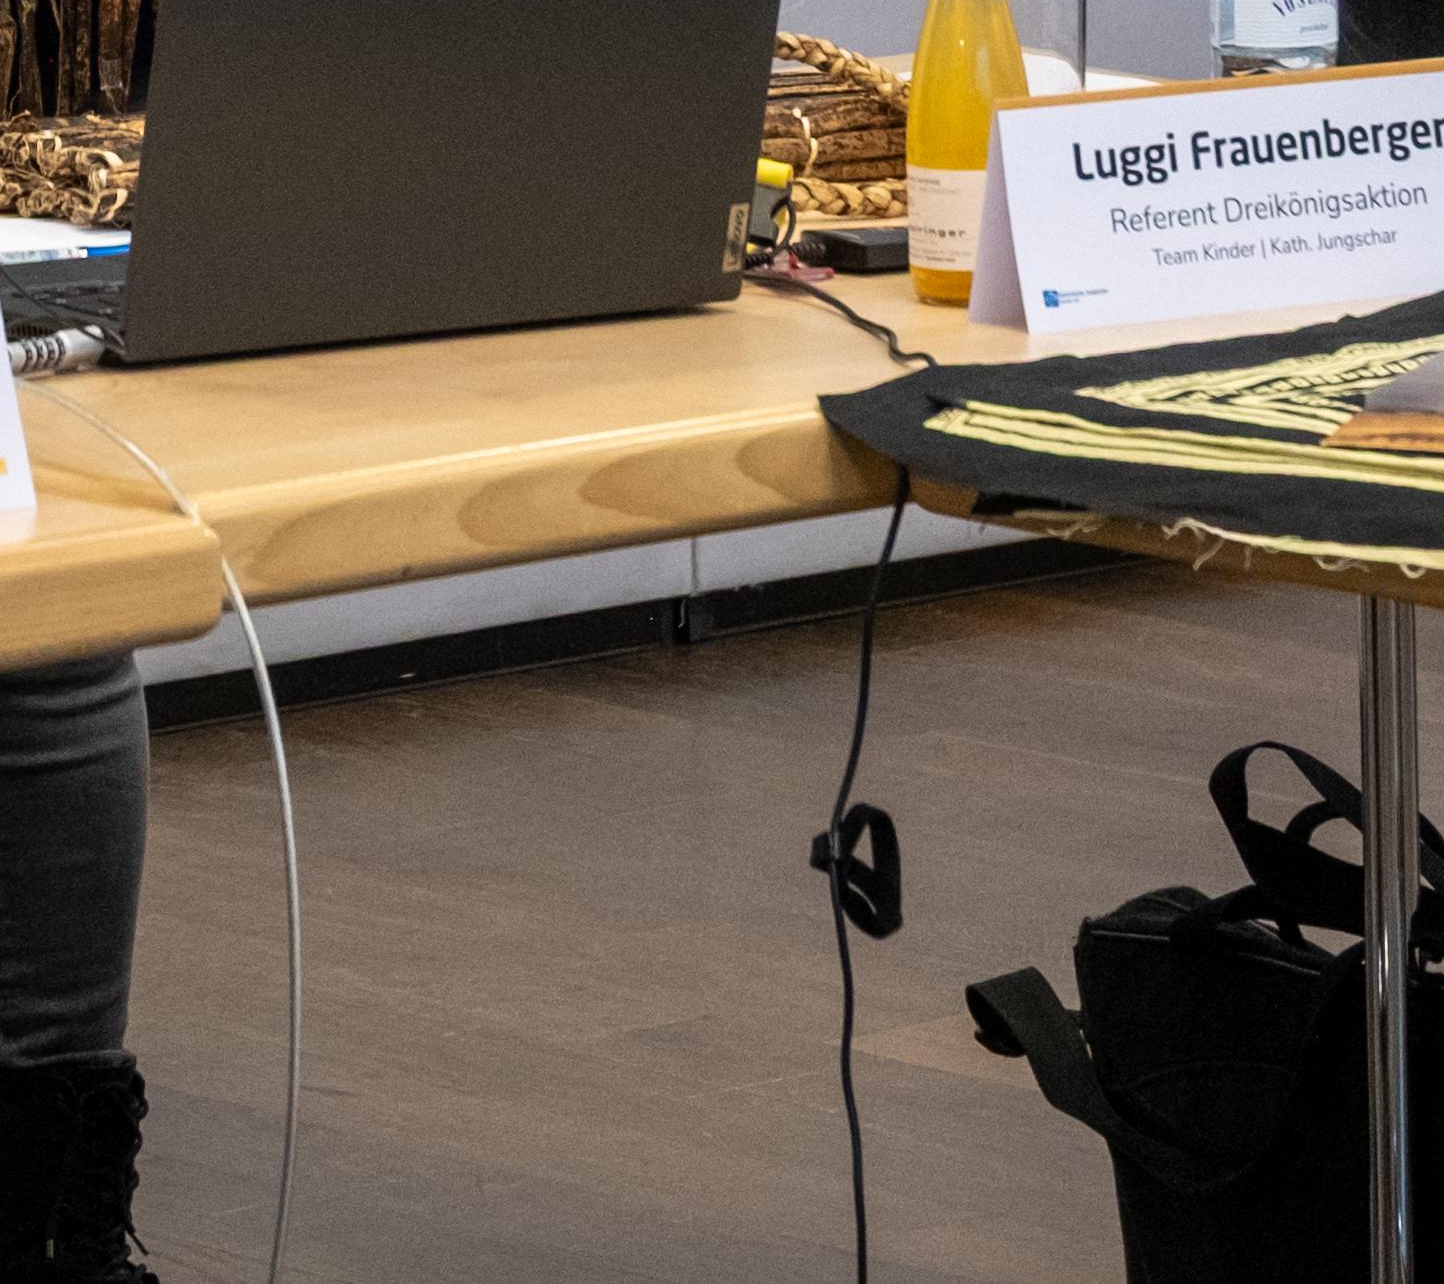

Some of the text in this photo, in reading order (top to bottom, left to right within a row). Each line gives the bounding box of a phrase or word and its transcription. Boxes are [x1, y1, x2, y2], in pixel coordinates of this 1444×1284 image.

[1072, 133, 1178, 186] Luggi
[1111, 182, 1429, 233] Referent Dreikönigsaktion
[1153, 247, 1199, 268] Team
[1203, 240, 1257, 262] Kinder
[1271, 236, 1311, 256] Kath.
[1316, 227, 1398, 253] Jungschar
